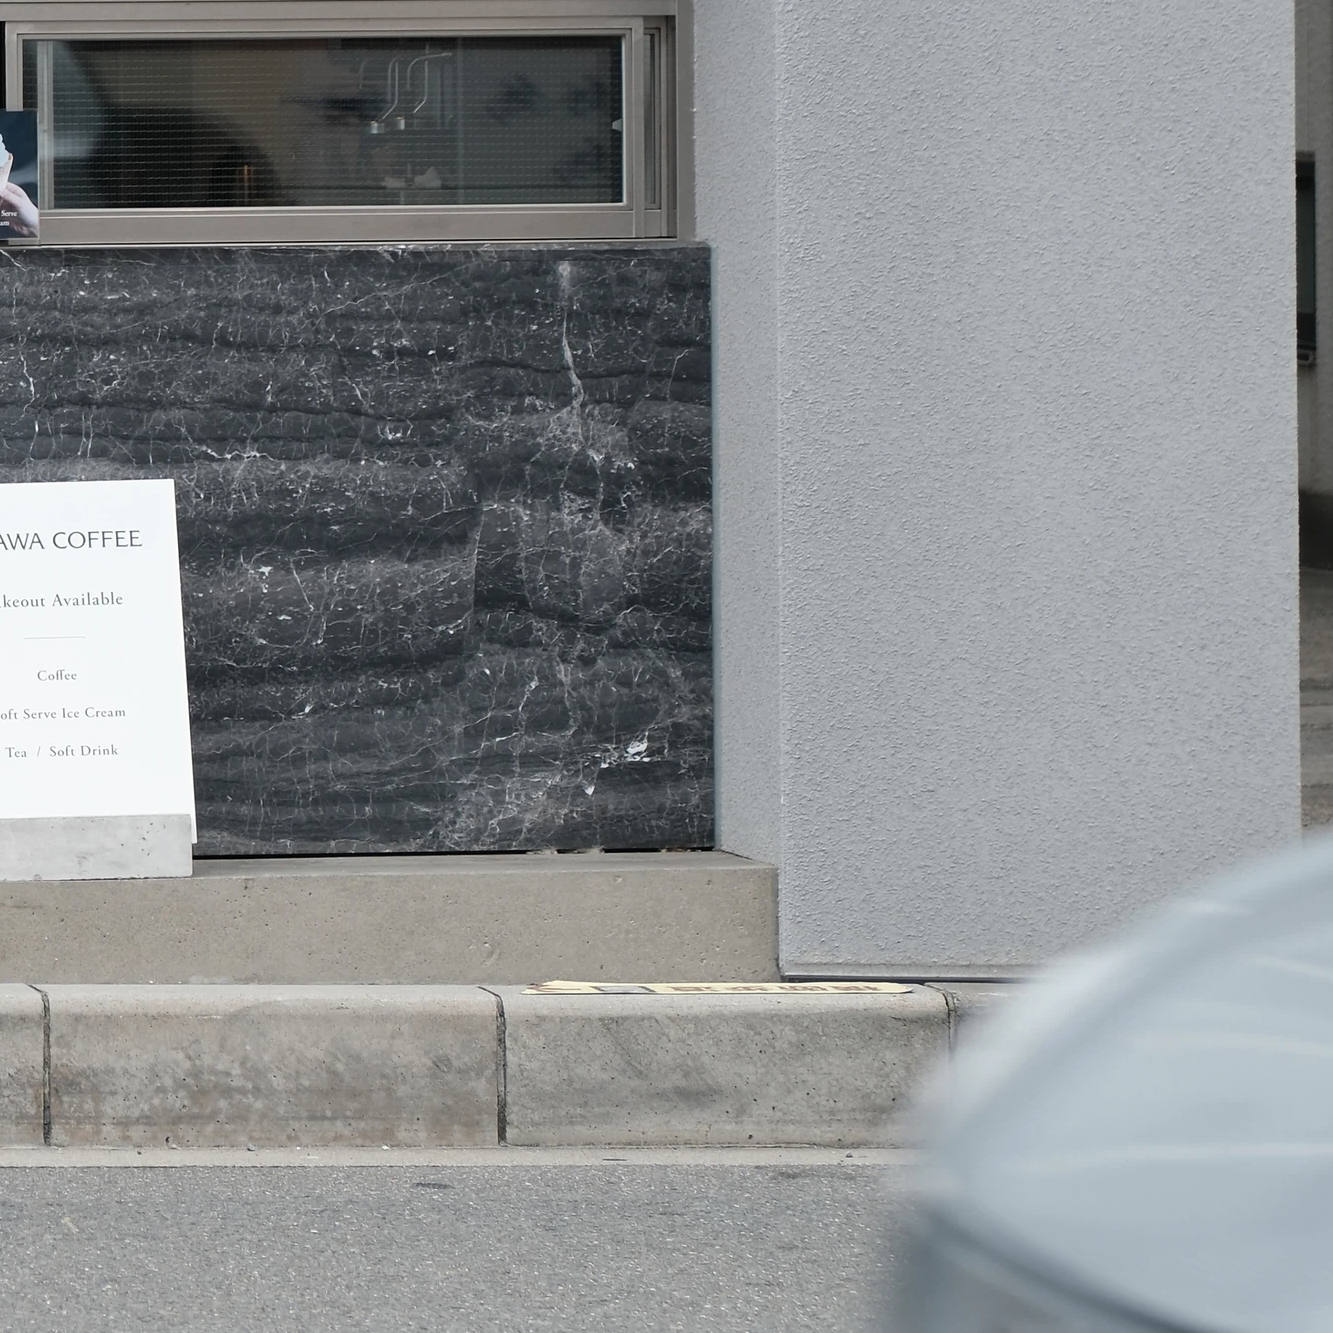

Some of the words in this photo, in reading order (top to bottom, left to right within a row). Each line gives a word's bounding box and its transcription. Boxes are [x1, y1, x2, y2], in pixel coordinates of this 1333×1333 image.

[52, 530, 143, 550] COFFEE
[51, 592, 123, 607] Available
[37, 669, 77, 682] Coffee
[23, 708, 57, 720] Serve
[61, 707, 80, 719] Ice
[84, 706, 126, 718] Cream
[5, 747, 27, 758] Tea
[49, 745, 76, 757] Soft
[80, 744, 119, 756] Drink
